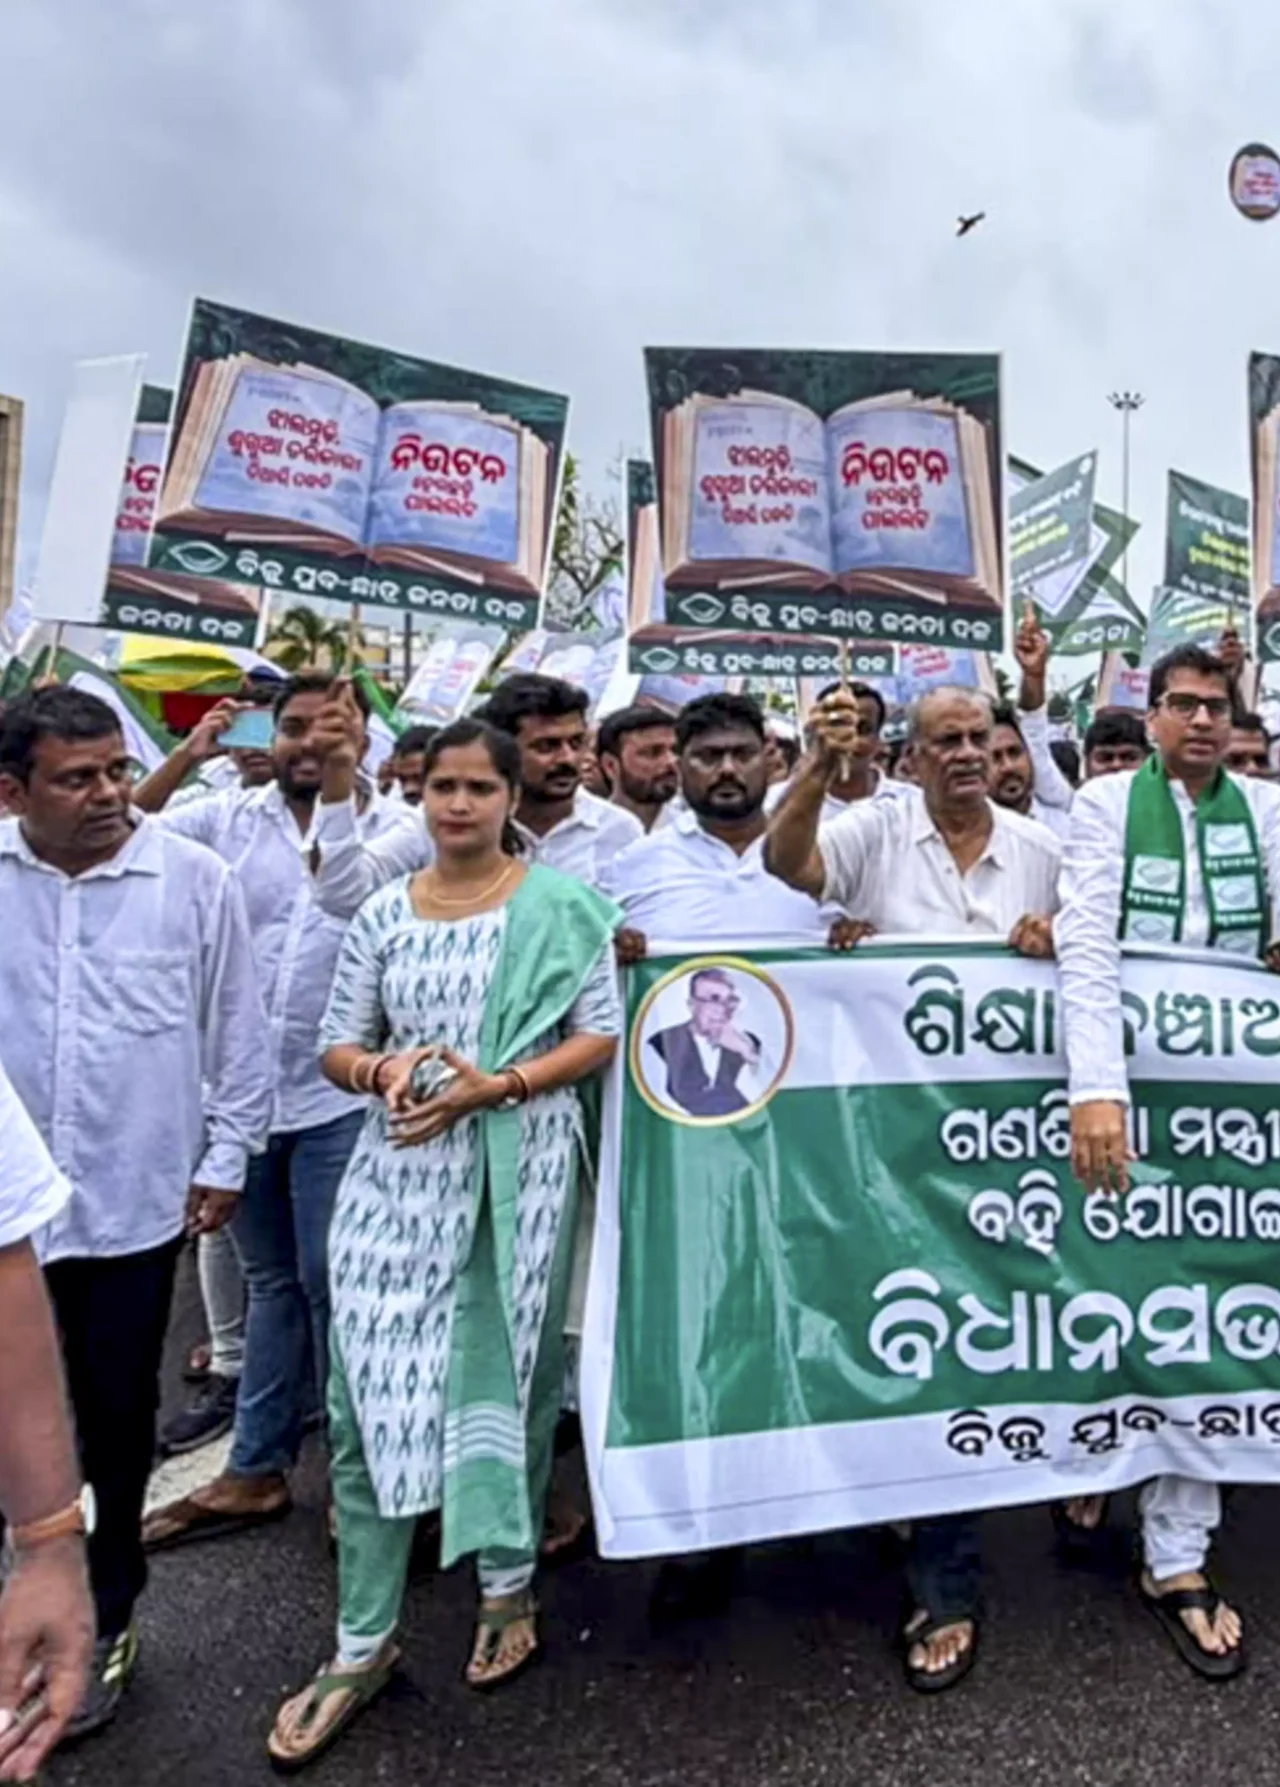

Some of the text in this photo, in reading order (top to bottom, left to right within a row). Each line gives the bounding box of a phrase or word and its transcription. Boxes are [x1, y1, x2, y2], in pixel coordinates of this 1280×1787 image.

[390, 433, 507, 486] ନିଉଟନ
[841, 441, 950, 488] ନିଉଟନ
[236, 549, 283, 586] ବିଜୁ
[407, 586, 477, 613] ଜନତା
[484, 598, 526, 621] ଦଳ
[117, 605, 192, 632] ଜନତା
[200, 617, 244, 638] ଦଳ
[730, 595, 772, 628] ବିଜୁ
[880, 612, 945, 636] ଜନତା
[952, 618, 993, 641] ଦଳ
[903, 963, 1055, 1056] ଶିକ୍ଷା
[967, 1168, 1063, 1255] ବହି
[946, 1408, 1051, 1461] ବିଜୁ
